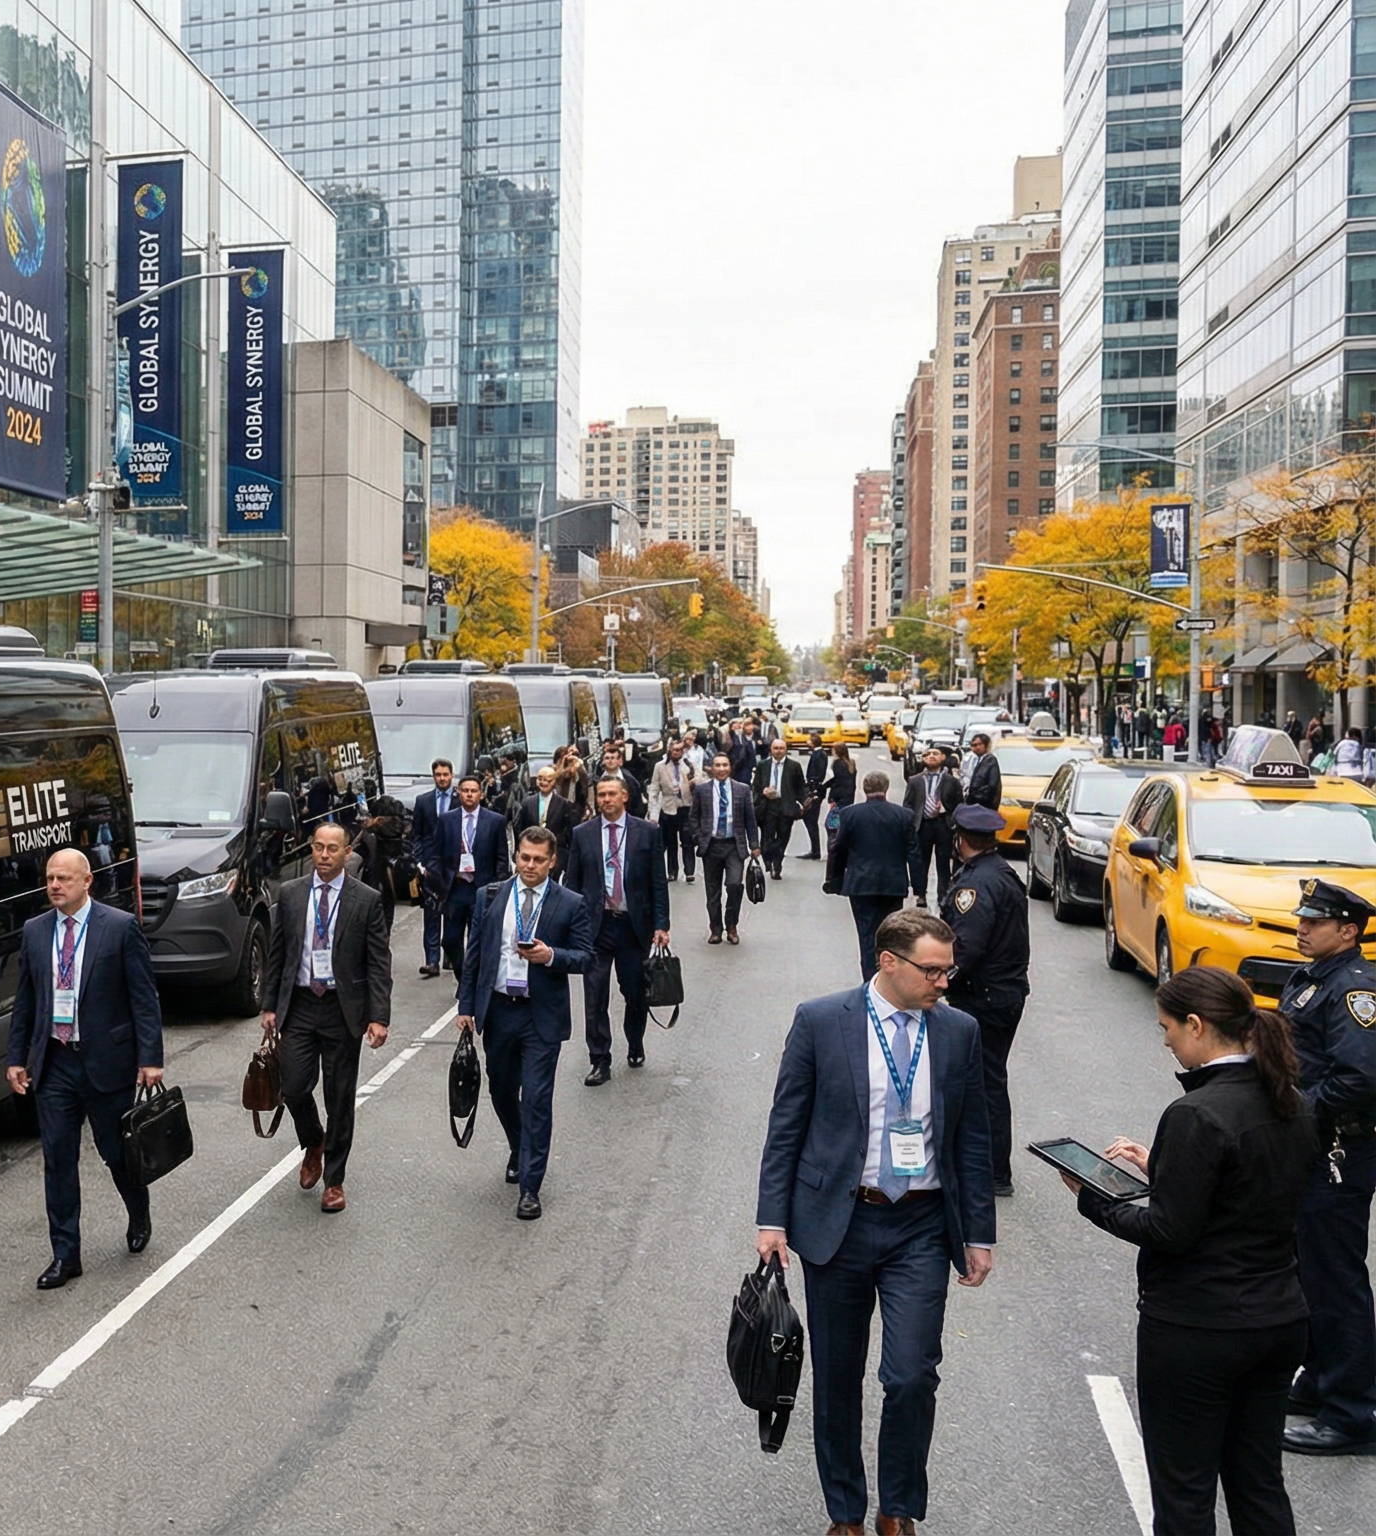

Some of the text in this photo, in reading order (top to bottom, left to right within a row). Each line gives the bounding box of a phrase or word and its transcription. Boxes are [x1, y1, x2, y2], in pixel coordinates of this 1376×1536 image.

[139, 229, 160, 413] GLOBAL SYNERGY
[245, 305, 264, 460] GLOBAL SYNERGY
[6, 406, 43, 446] 2024
[6, 779, 70, 827] ELITE
[12, 821, 72, 854] TRANSPORT
